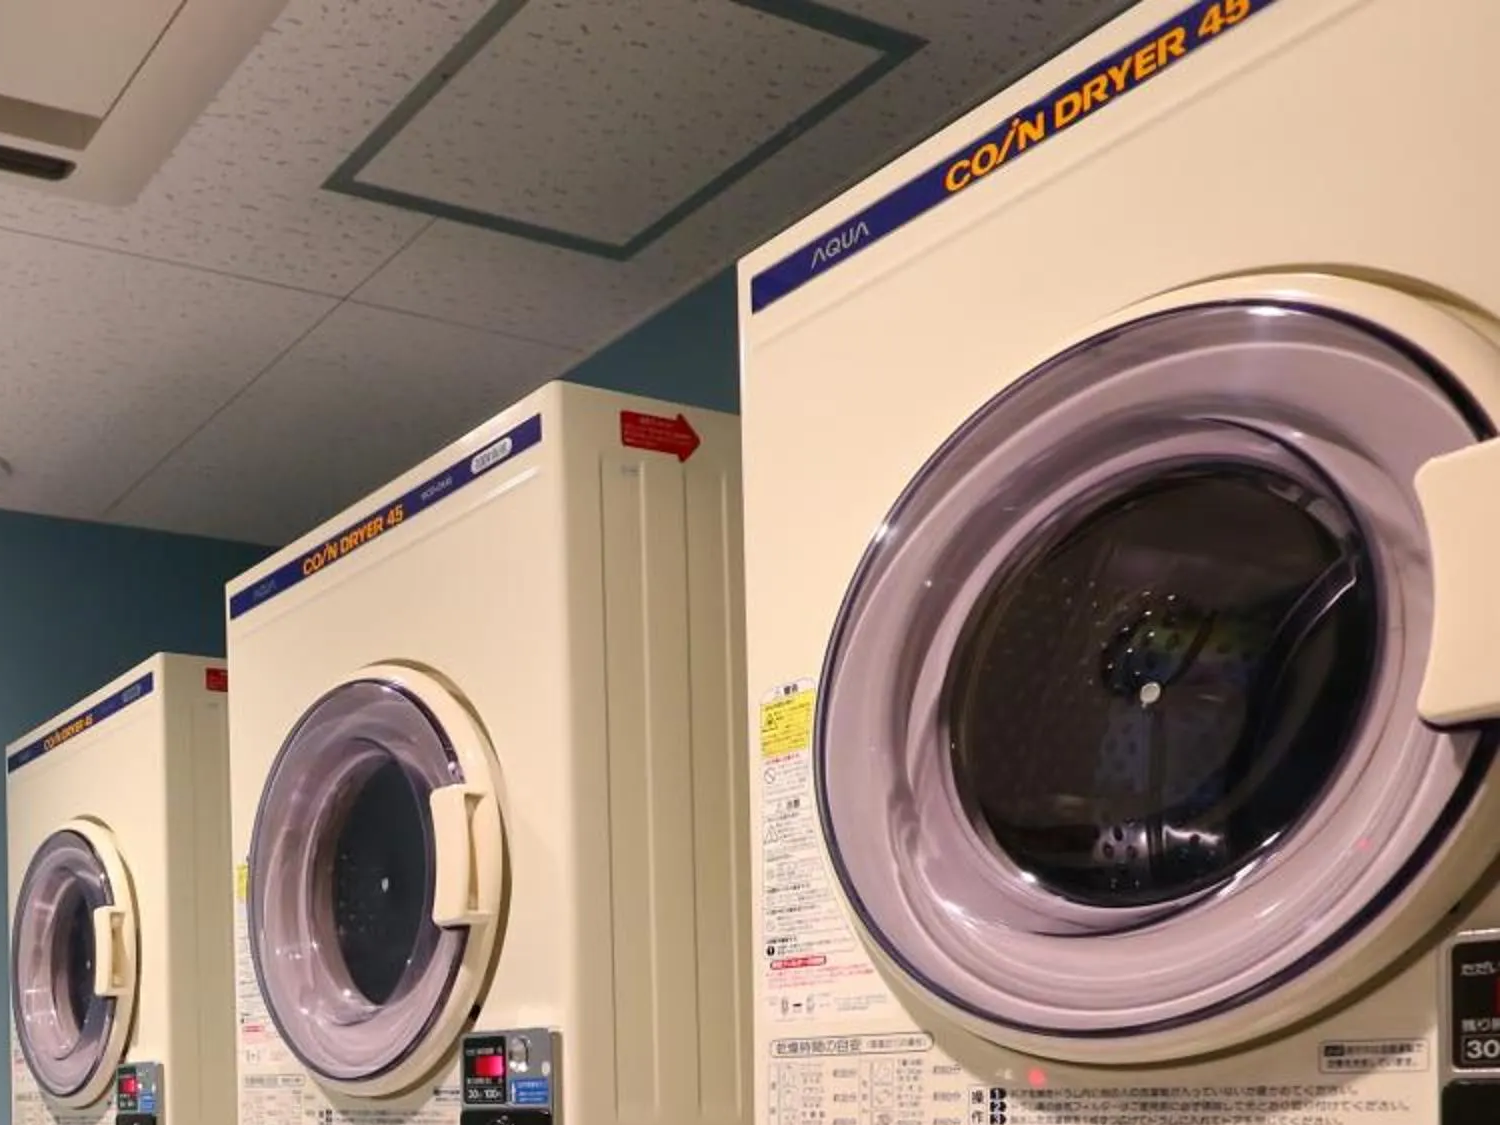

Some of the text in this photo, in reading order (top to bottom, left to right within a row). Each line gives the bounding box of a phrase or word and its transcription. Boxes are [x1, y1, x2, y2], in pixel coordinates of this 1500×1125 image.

[810, 0, 1251, 269] AQUA COIN DRYER 45
[303, 541, 339, 576] COIN
[340, 516, 384, 551] DRYER
[387, 504, 404, 527] 45
